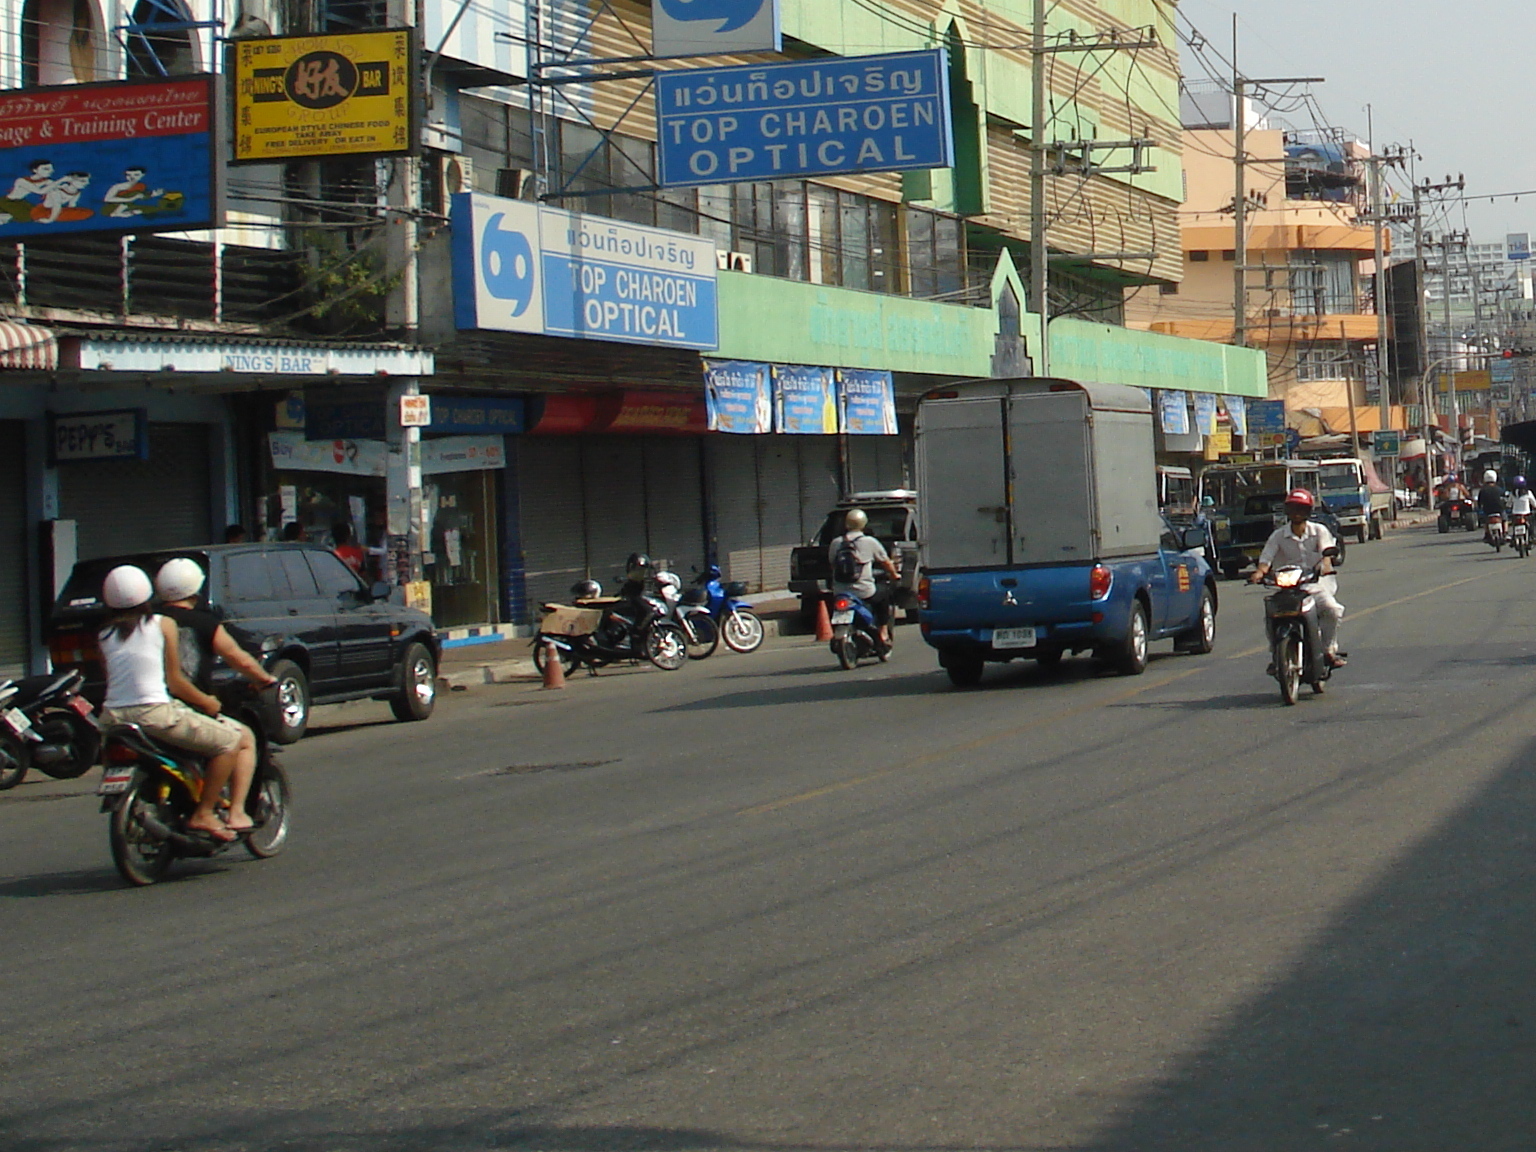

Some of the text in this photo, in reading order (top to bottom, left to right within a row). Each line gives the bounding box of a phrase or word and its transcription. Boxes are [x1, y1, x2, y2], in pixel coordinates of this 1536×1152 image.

[362, 70, 382, 89] BAR
[674, 66, 922, 107] แว่นท็อปเจริญ
[39, 125, 54, 138] &
[61, 116, 138, 137] Training
[143, 111, 202, 130] Center
[669, 101, 934, 145] TOP CHAROEN
[688, 135, 916, 176] OPTICAL
[566, 225, 695, 270] แว่นท็อปเจริญ
[568, 262, 697, 308] TOP CHAROEN
[584, 299, 686, 338] OPTICAL
[225, 354, 312, 372] NING'S BAR
